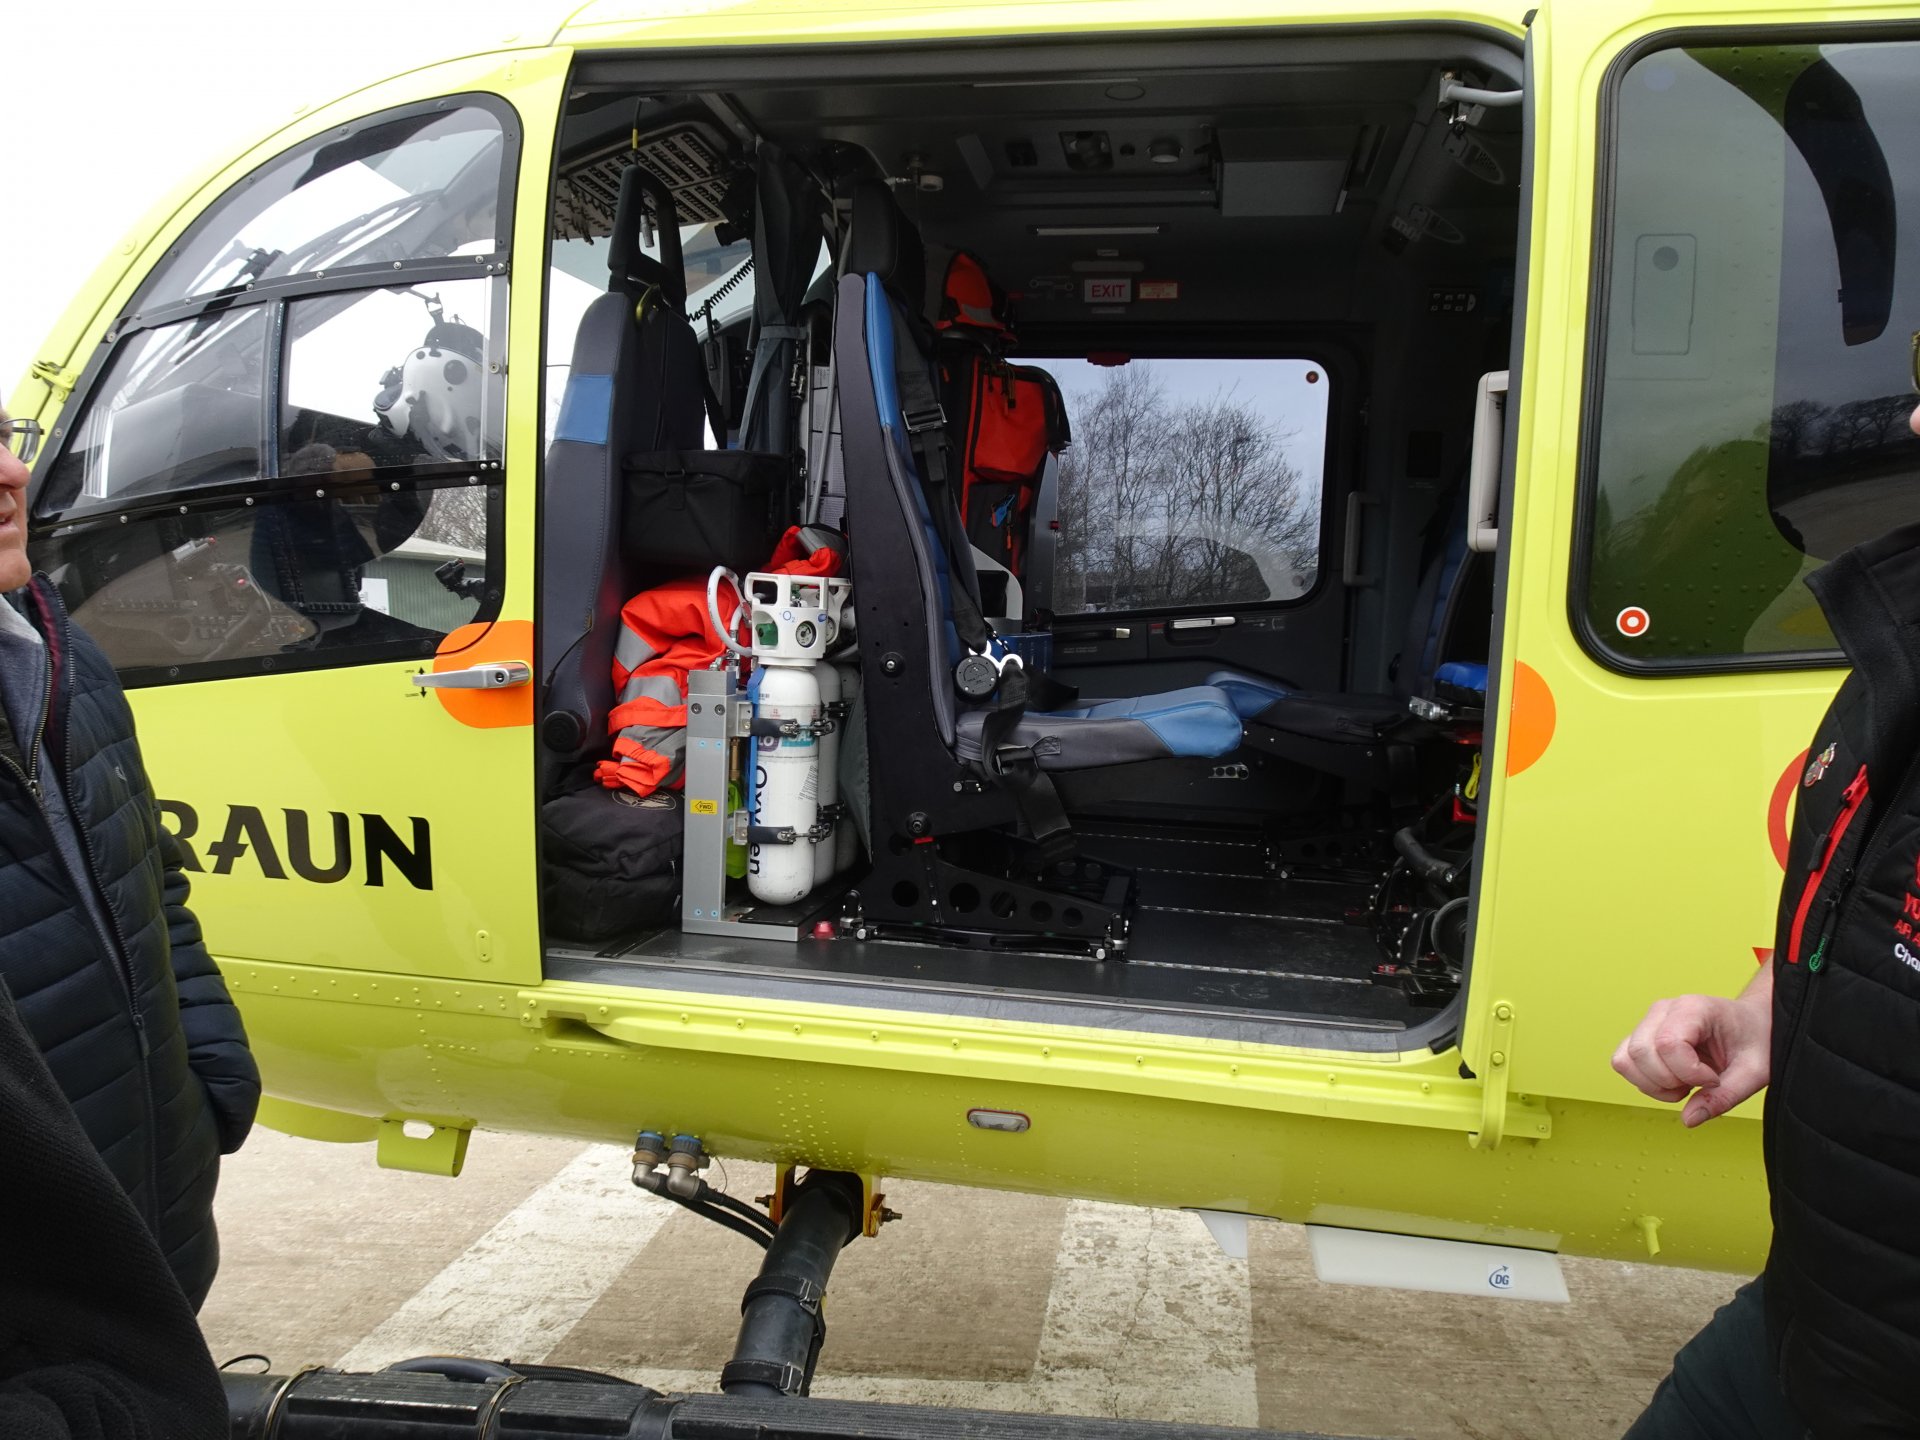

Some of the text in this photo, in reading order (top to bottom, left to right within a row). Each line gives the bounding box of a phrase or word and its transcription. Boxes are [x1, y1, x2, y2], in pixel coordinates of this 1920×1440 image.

[1091, 284, 1126, 298] EXIT
[749, 765, 768, 875] Oxyen
[1495, 1274, 1510, 1285] DG
